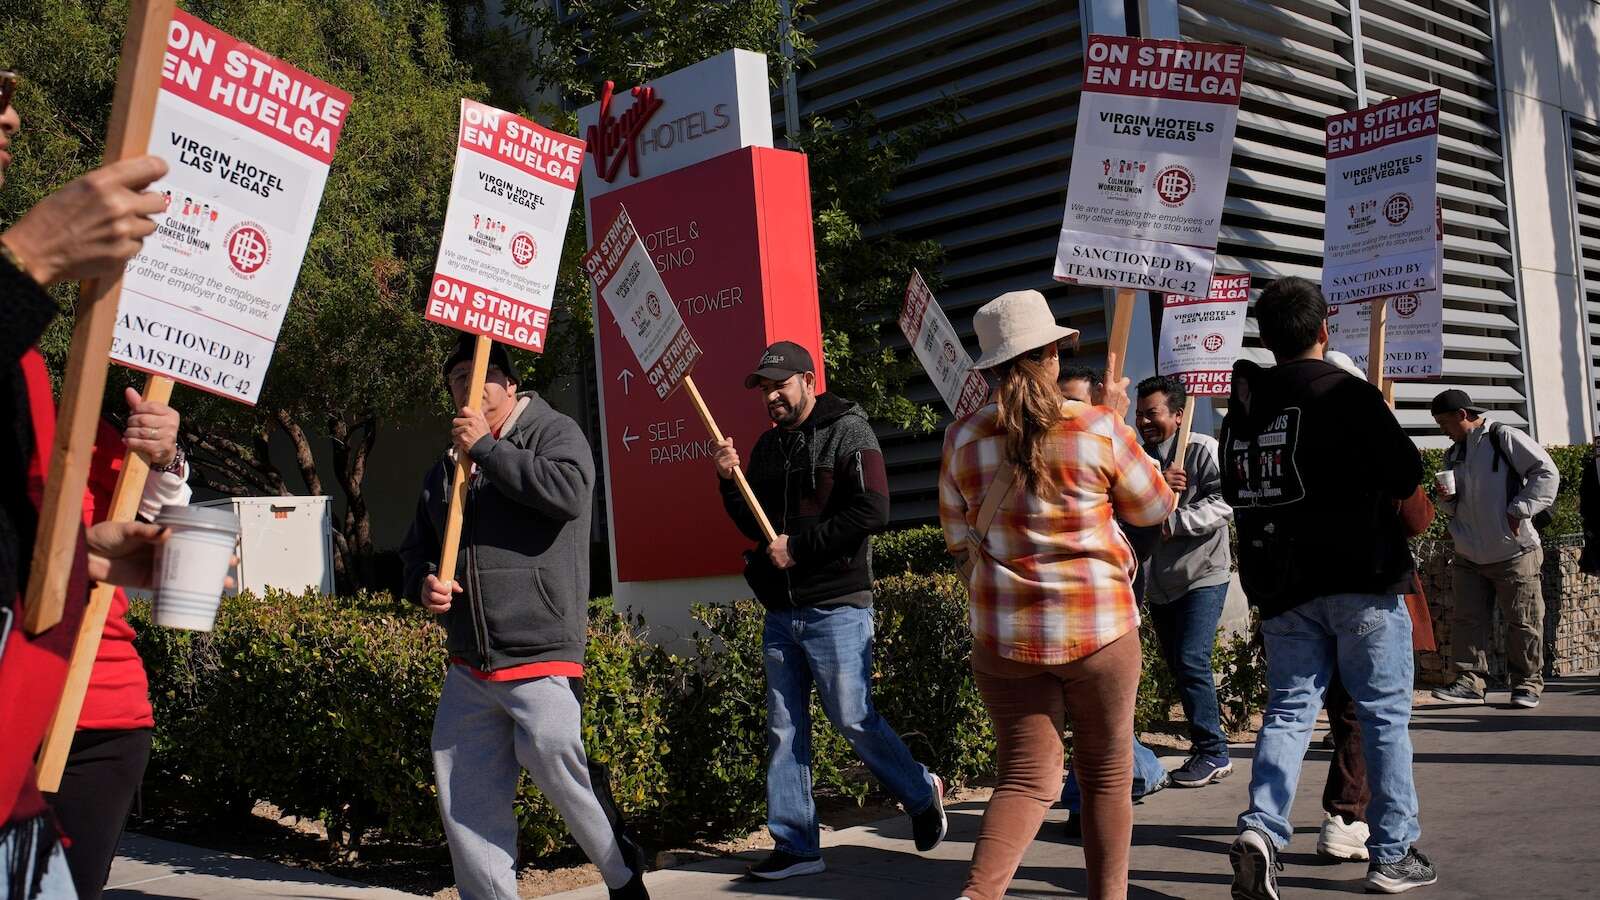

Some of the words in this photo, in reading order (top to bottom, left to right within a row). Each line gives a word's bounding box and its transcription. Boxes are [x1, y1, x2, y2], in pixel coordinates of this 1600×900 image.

[167, 20, 216, 64] ON
[224, 50, 345, 126] STRIKE
[1089, 43, 1129, 64] ON
[1137, 47, 1241, 73] STRIKE
[1087, 66, 1120, 86] EN
[1129, 70, 1236, 96] HUELGA
[161, 52, 202, 92] EN
[209, 76, 331, 154] HUELGA
[1327, 117, 1357, 136] ON
[1364, 96, 1438, 128] STRIKE
[465, 107, 499, 132] ON
[505, 120, 583, 165] STRIKE
[586, 80, 664, 184] Virgin
[641, 104, 730, 156] HOTELS
[1100, 112, 1150, 126] VIRGIN
[1155, 117, 1215, 133] HOTELS
[1113, 124, 1141, 136] LAS
[1147, 128, 1196, 142] VEGAS
[1328, 136, 1354, 153] EN
[1360, 114, 1435, 146] HUELGA
[171, 132, 231, 167] VIRGIN
[236, 160, 284, 192] HOTEL
[463, 126, 493, 150] EN
[498, 140, 576, 183] HUELGA
[1343, 165, 1377, 180] VIRGIN
[1380, 155, 1423, 170] HOTELS
[180, 152, 212, 174] LAS
[220, 166, 270, 198] VEGAS
[479, 170, 514, 191] VIRGIN
[515, 185, 545, 206] HOTEL
[1098, 183, 1123, 192] WORKERS
[1124, 185, 1142, 194] UNION
[1108, 177, 1134, 186] CULINARY
[1354, 175, 1372, 186] LAS
[1376, 166, 1410, 179] VEGAS
[484, 182, 504, 197] LAS
[507, 192, 536, 211] VEGAS
[690, 221, 700, 240] &
[1114, 218, 1151, 229] employer
[1164, 224, 1181, 233] stop
[1115, 209, 1141, 219] asking
[1143, 211, 1156, 219] the
[1159, 214, 1202, 225] employees
[187, 235, 210, 251] UNION
[445, 249, 456, 258] We
[586, 252, 603, 273] ON
[600, 210, 630, 256] STRIKE
[593, 267, 608, 286] EN
[606, 226, 635, 269] HUELGA
[1072, 246, 1171, 270] SANCTIONED
[1175, 261, 1196, 273] BY
[137, 266, 165, 282] other
[168, 276, 216, 297] employer
[217, 294, 227, 304] to
[228, 299, 248, 312] stop
[150, 258, 168, 271] not
[170, 266, 205, 282] asking
[206, 278, 223, 290] the
[225, 285, 270, 309] employees
[271, 304, 282, 312] of
[1067, 263, 1155, 287] TEAMSTERS
[1158, 278, 1178, 290] JC
[1181, 281, 1196, 292] 42
[1211, 278, 1248, 289] RIKE
[1328, 281, 1393, 301] TEAMSTERS
[1395, 280, 1410, 290] JC
[1413, 278, 1425, 288] 42
[1332, 265, 1403, 287] SANCTIONED
[1406, 263, 1423, 274] BY
[433, 279, 467, 304] ON
[472, 291, 548, 330] STRIKE
[687, 286, 744, 316] TOWER
[1167, 295, 1185, 304] EN
[429, 299, 459, 322] EN
[463, 309, 541, 348] HUELGA
[118, 312, 232, 362] ANCTIONED
[234, 348, 256, 370] BY
[1415, 351, 1429, 360] BY
[111, 336, 213, 383] EAMSTERS
[212, 373, 235, 390] JC
[236, 378, 251, 396] 42
[650, 368, 664, 386] ON
[663, 330, 691, 372] STRIKE
[656, 382, 670, 400] EN
[668, 343, 699, 384] HUELGA
[1186, 384, 1231, 393] UELGA
[648, 418, 685, 442] SELF
